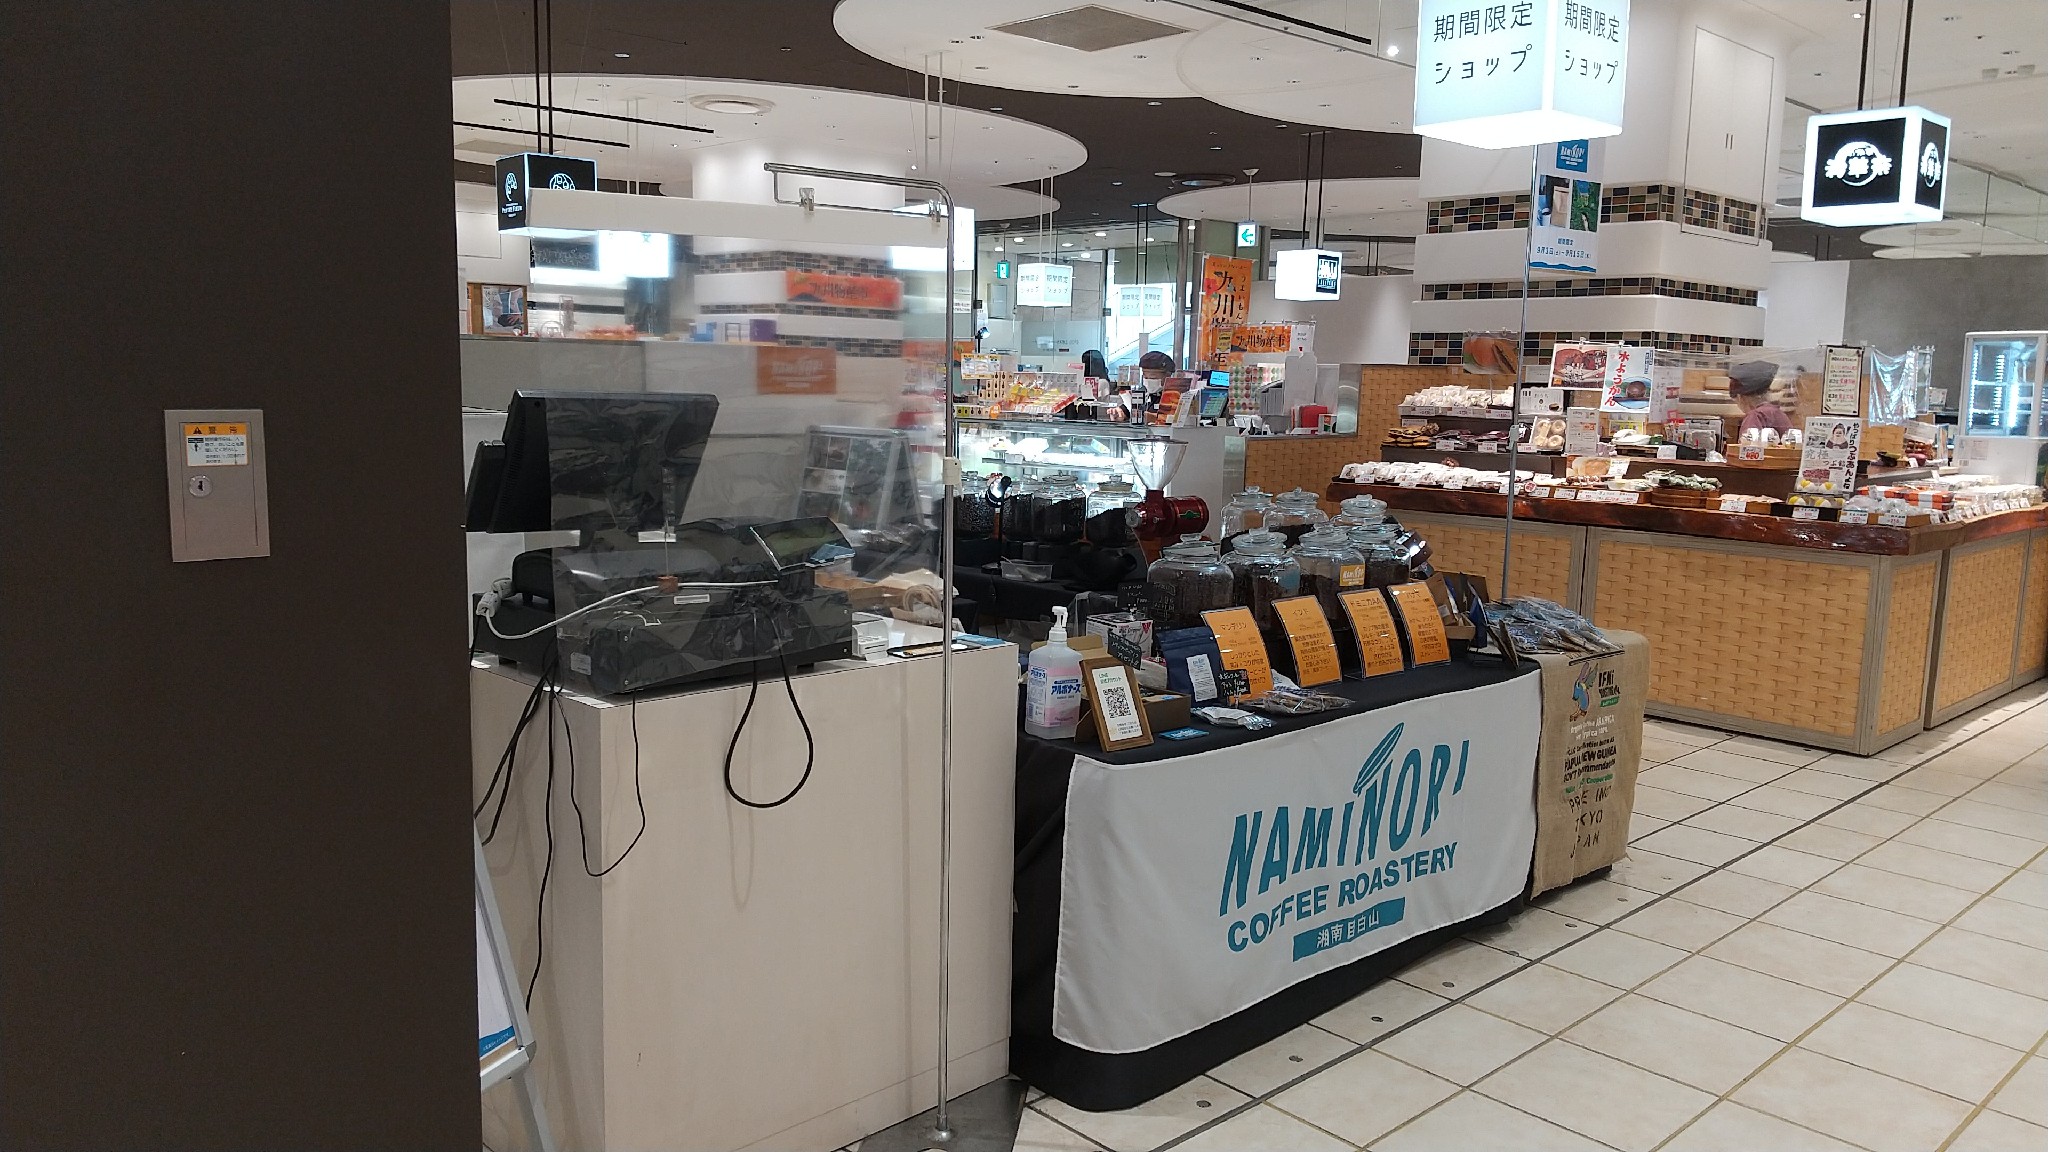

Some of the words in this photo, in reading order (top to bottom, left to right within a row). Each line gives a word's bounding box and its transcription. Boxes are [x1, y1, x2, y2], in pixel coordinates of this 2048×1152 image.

[1433, 0, 1533, 43] 期間限定
[1564, 0, 1620, 43] 期間限定
[1435, 44, 1533, 85] ショップ
[1564, 50, 1619, 84] ショップ
[1604, 350, 1630, 407] 水ようかん
[1220, 622, 1247, 631] マンデリン
[1050, 683, 1082, 696] アルボナース
[1219, 739, 1470, 918] NAMINORI
[1227, 884, 1330, 953] COFFEE
[1337, 841, 1458, 908] ROASTERY
